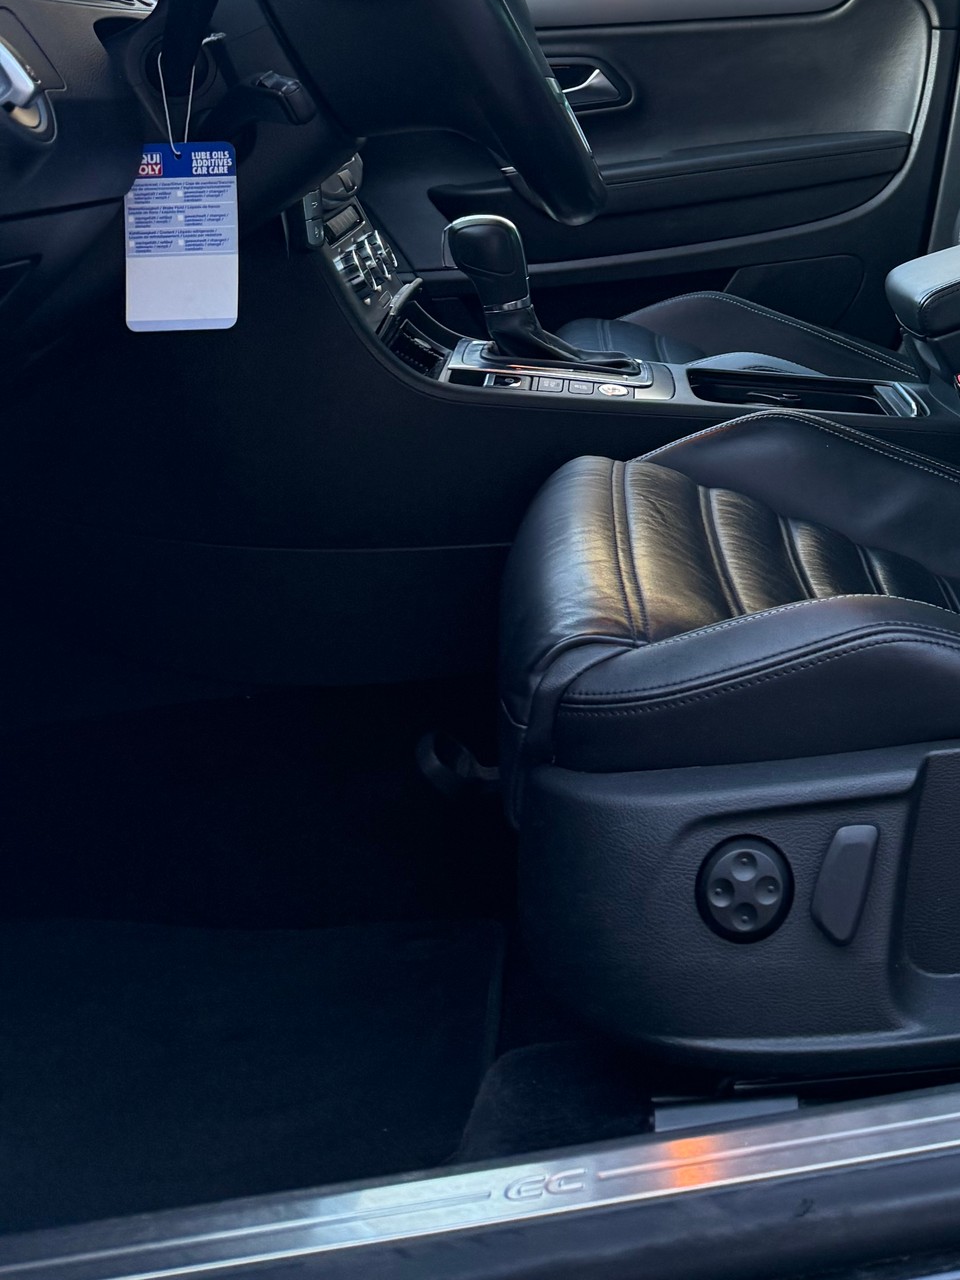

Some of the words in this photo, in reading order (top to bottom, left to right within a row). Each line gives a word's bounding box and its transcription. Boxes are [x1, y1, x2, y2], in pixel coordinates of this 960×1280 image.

[141, 153, 161, 164] QUI
[191, 151, 211, 160] LUBE
[212, 150, 229, 159] OILS
[192, 158, 233, 167] ADDITIVES
[139, 164, 161, 175] OLY
[192, 166, 208, 175] CAR
[208, 165, 228, 174] CARE
